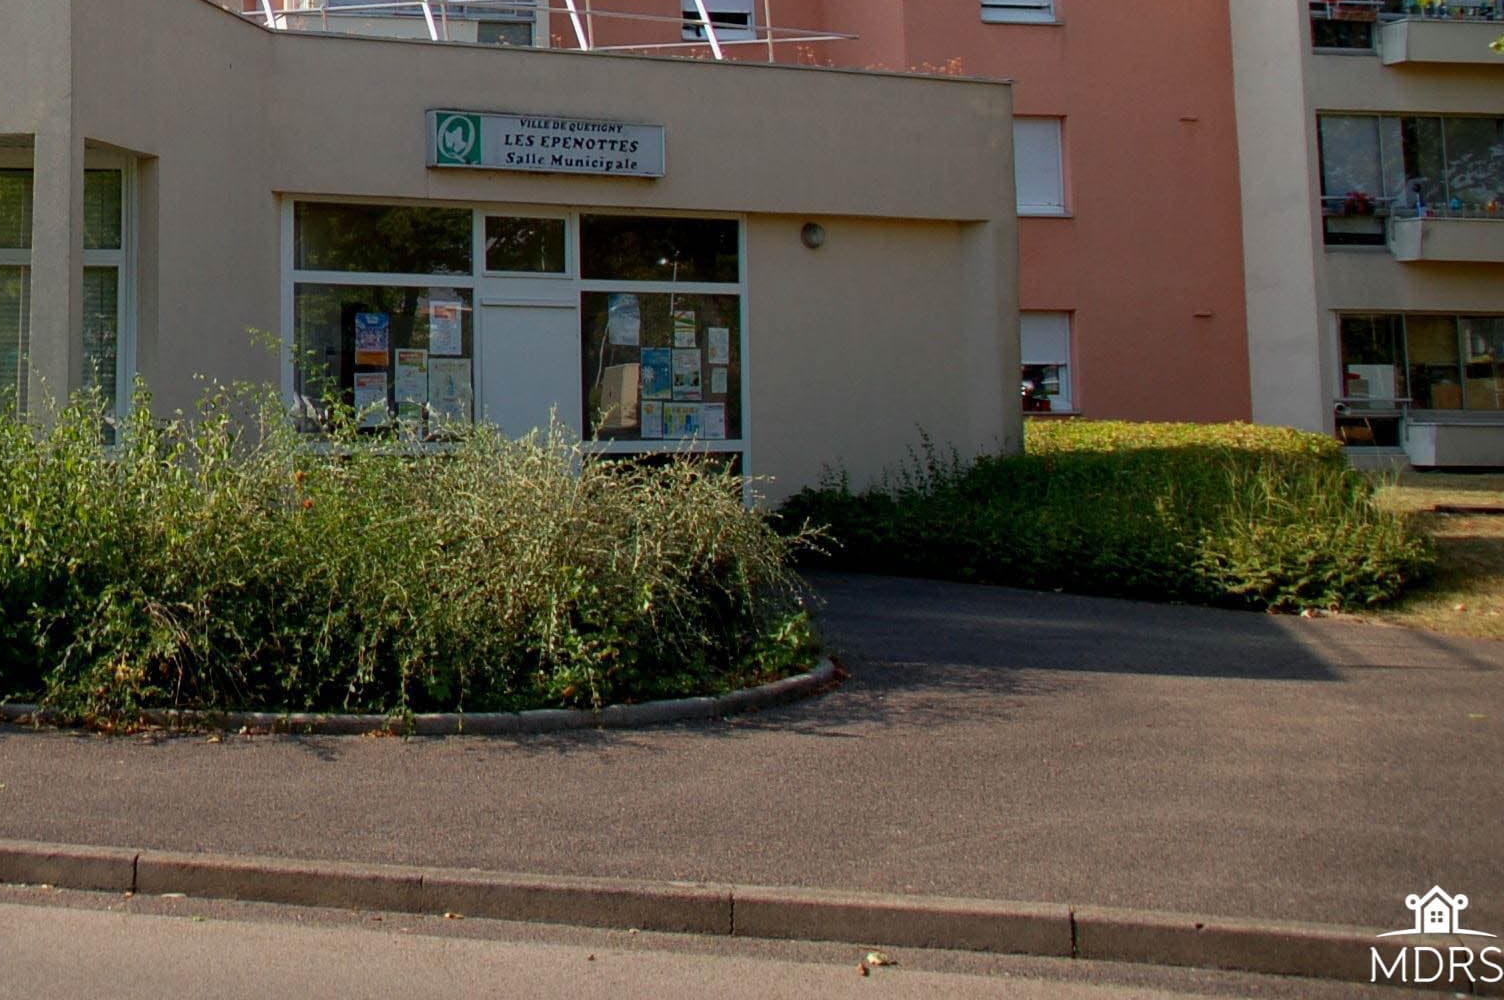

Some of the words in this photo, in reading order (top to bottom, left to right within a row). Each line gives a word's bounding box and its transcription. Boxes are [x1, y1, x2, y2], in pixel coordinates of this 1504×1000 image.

[520, 119, 549, 130] VILLE
[552, 121, 567, 131] DE
[569, 121, 623, 134] QUETIGNY
[504, 133, 535, 147] LES
[540, 135, 639, 153] EPENOTTES
[506, 152, 545, 165] Salle
[551, 154, 638, 172] Municipale
